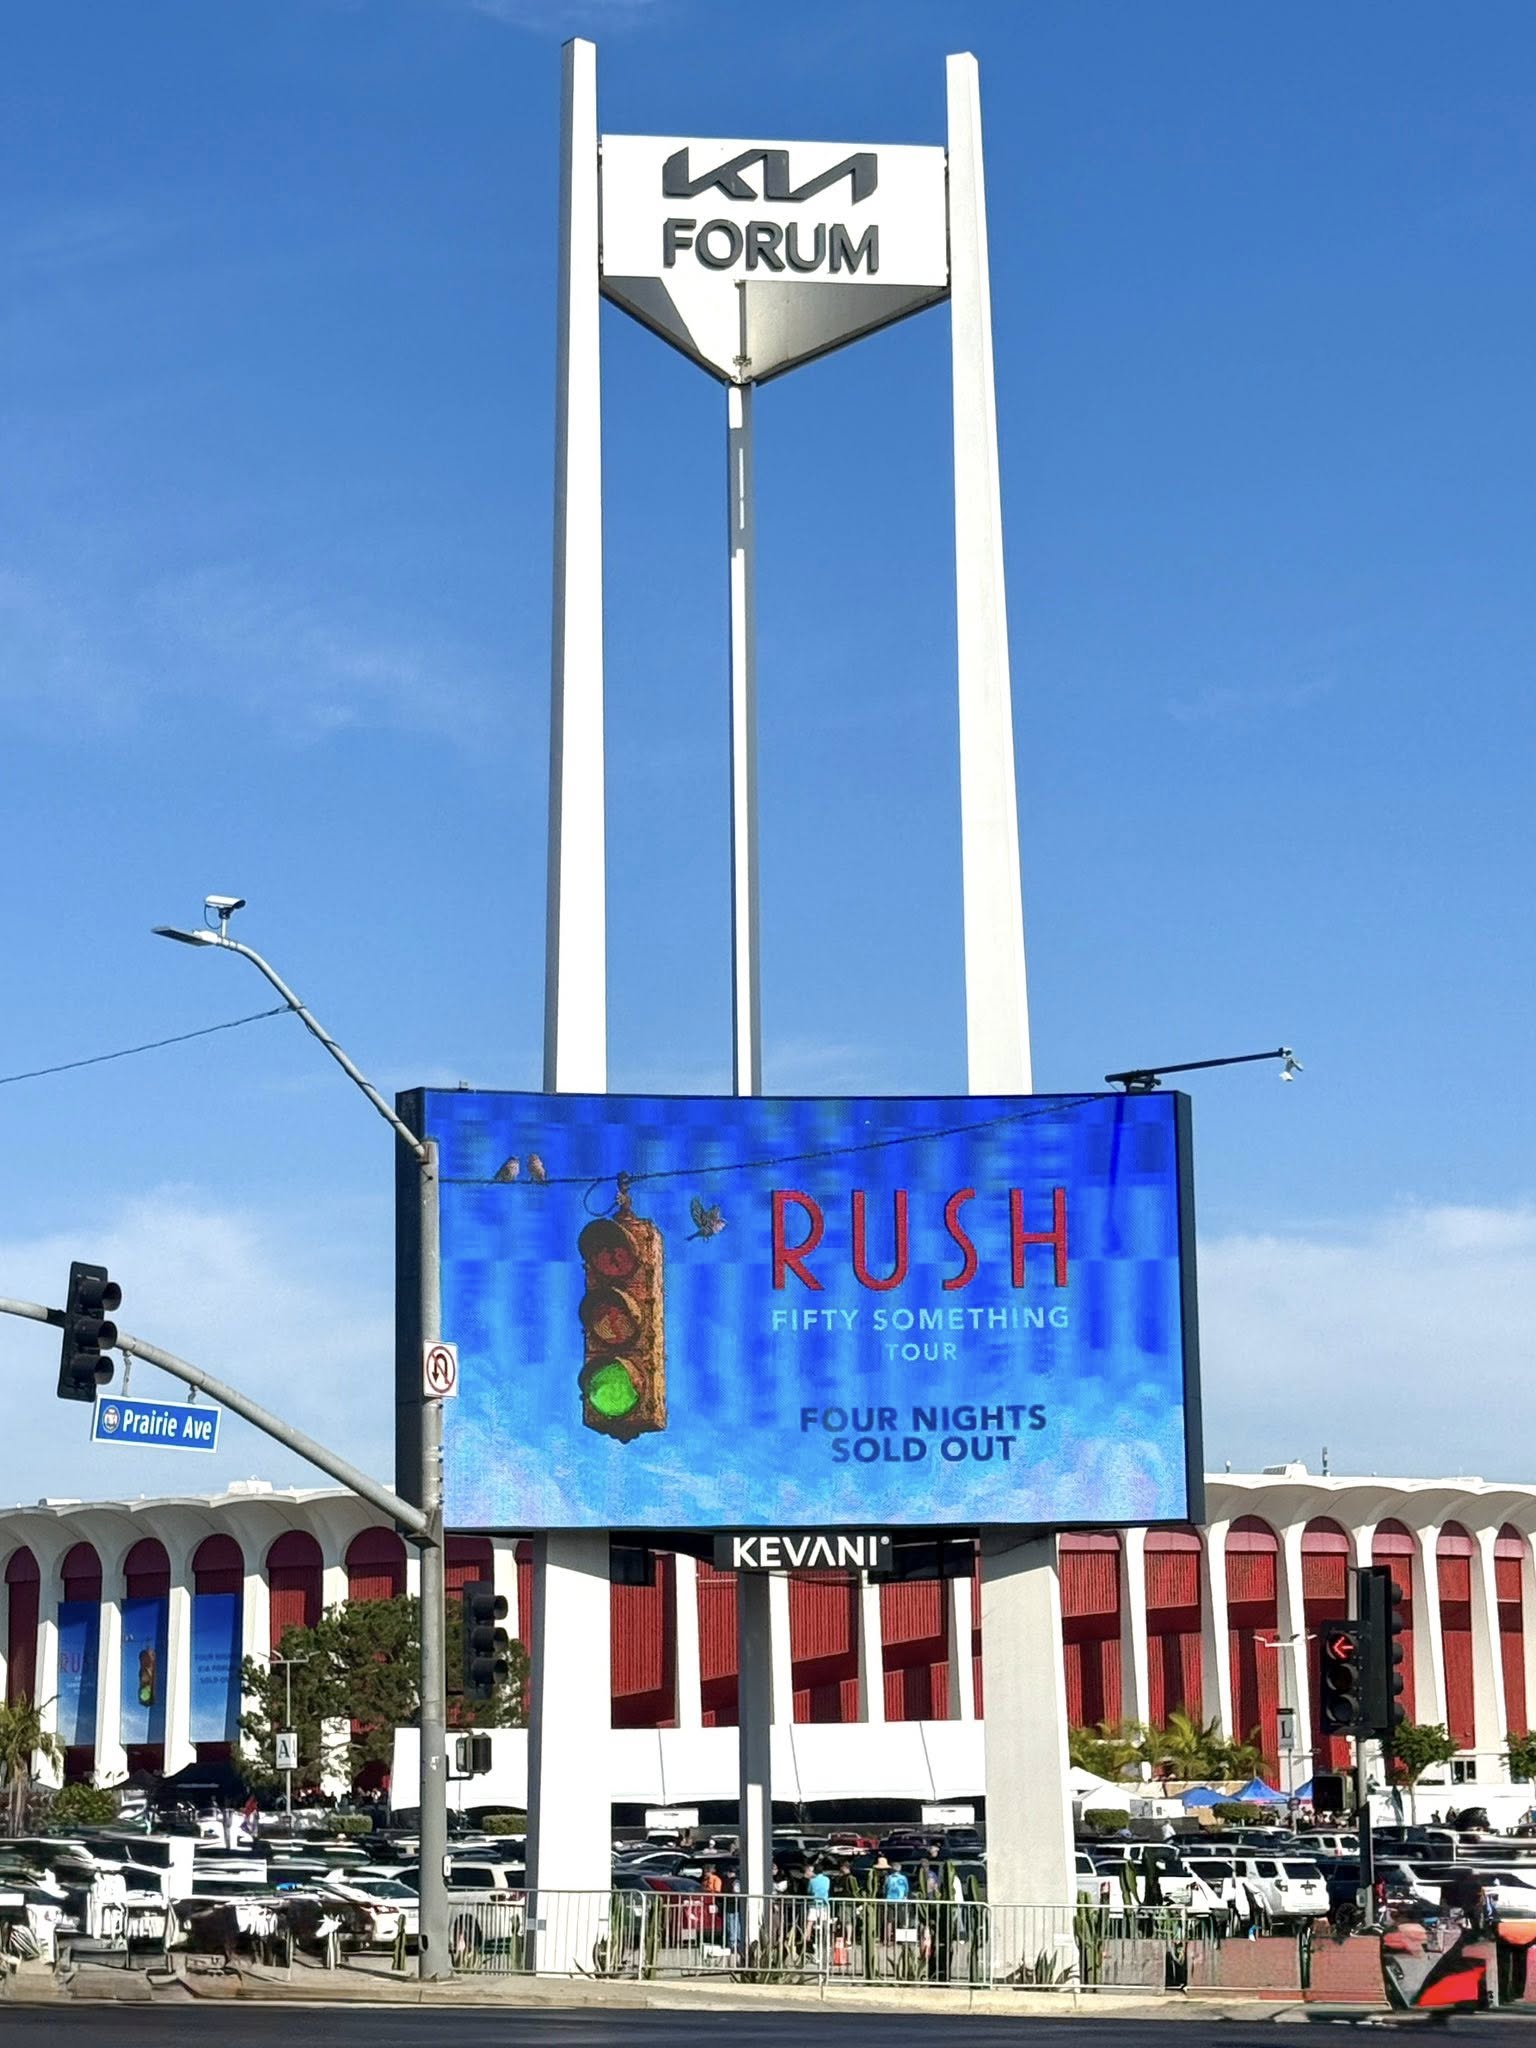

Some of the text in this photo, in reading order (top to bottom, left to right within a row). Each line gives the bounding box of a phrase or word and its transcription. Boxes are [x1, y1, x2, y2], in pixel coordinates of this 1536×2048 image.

[662, 147, 878, 206] KIA
[663, 217, 879, 275] FORUM
[771, 1187, 1069, 1291] RUSH
[771, 1306, 1069, 1331] FIFTY SOMETHING
[885, 1343, 957, 1361] TOUR
[122, 1408, 213, 1440] Prairie Ave
[800, 1404, 1047, 1432] FOUR NIGHTS
[831, 1435, 1016, 1463] SOLD OUT
[1281, 1720, 1292, 1739] L
[278, 1739, 290, 1759] A
